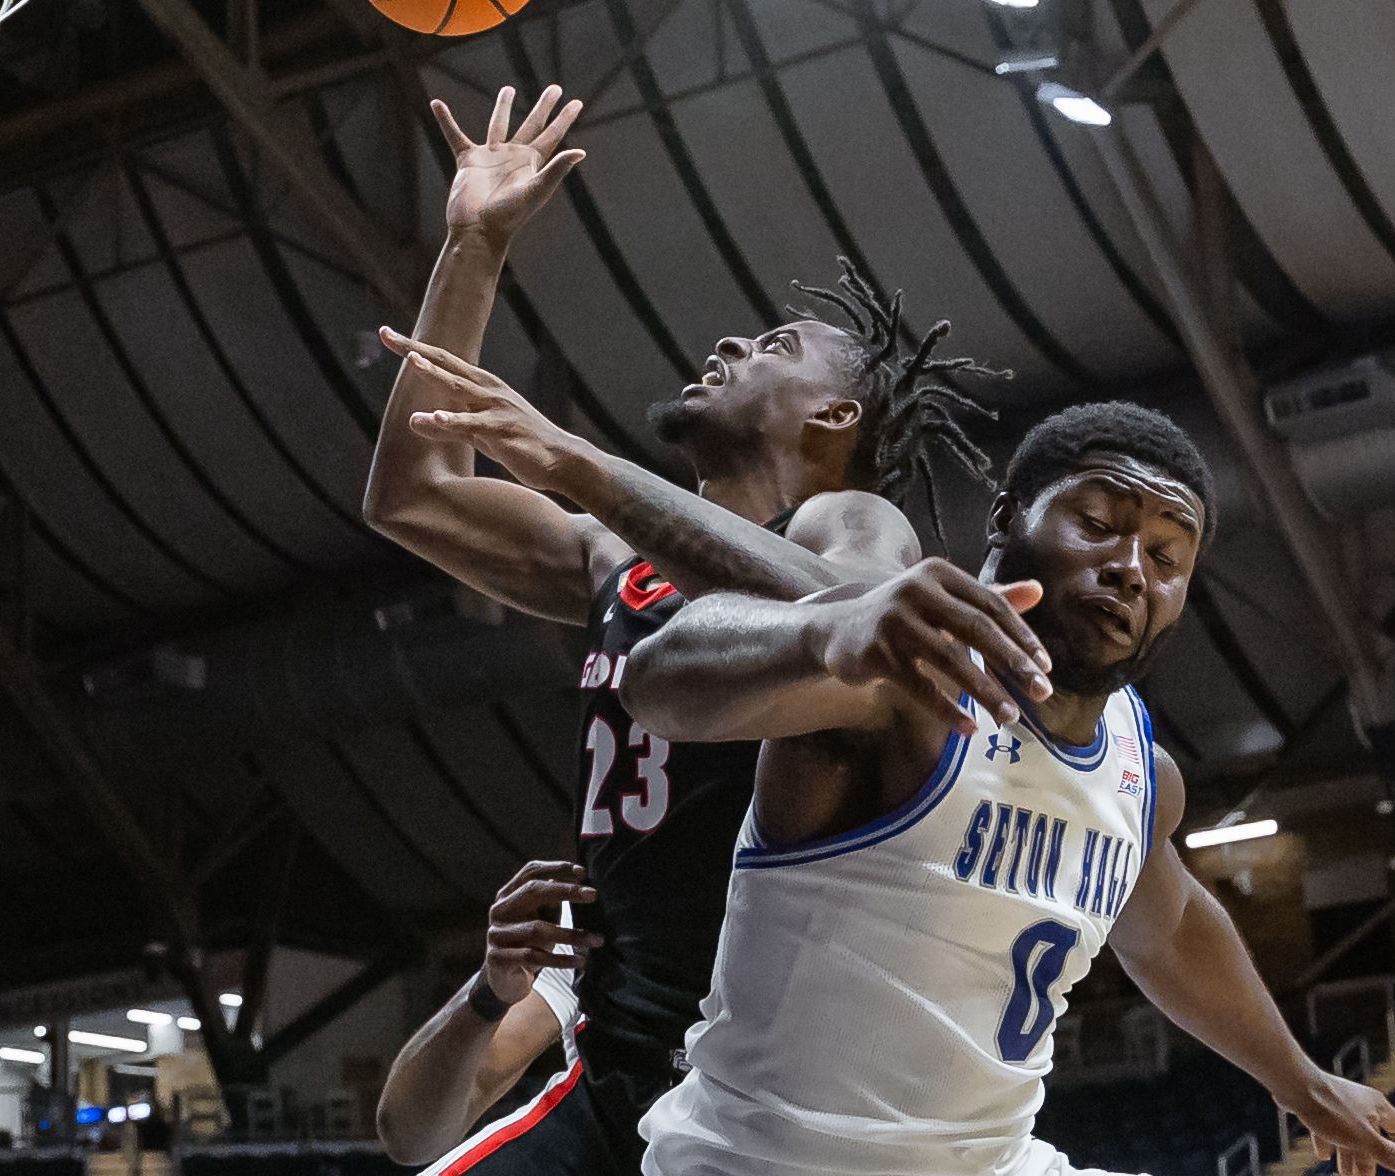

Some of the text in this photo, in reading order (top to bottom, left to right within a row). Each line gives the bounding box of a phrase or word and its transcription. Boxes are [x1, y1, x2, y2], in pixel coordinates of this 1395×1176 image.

[580, 715, 671, 838] 23
[1119, 780, 1143, 795] EAST
[1122, 770, 1140, 784] BIG
[954, 799, 1136, 921] SETON HALL
[995, 916, 1081, 1063] 0
